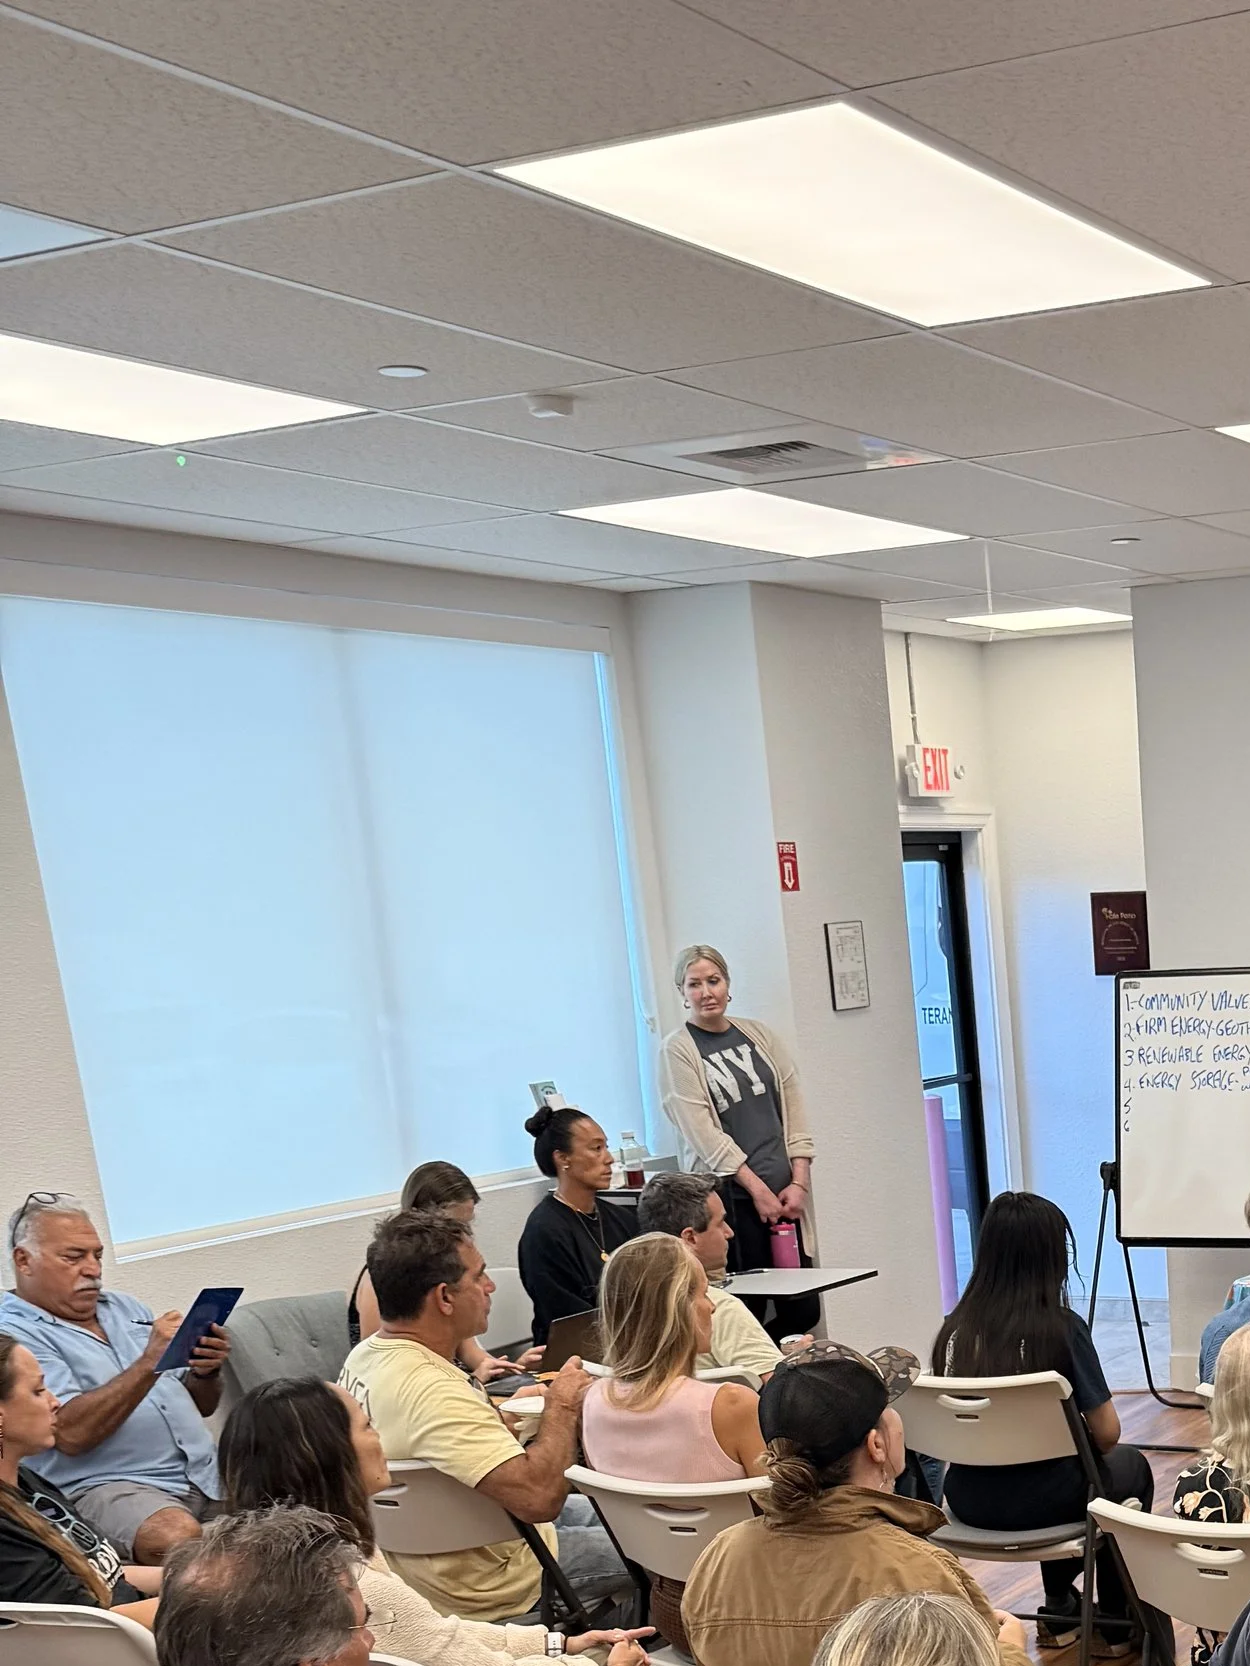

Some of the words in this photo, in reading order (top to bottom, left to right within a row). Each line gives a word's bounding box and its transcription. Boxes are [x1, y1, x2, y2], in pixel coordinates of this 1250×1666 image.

[922, 747, 950, 791] EXIT
[778, 843, 796, 854] FIRE
[1137, 1044, 1204, 1067] RENEWABLE
[702, 1043, 766, 1114] NY
[1138, 1071, 1182, 1092] ENERGY
